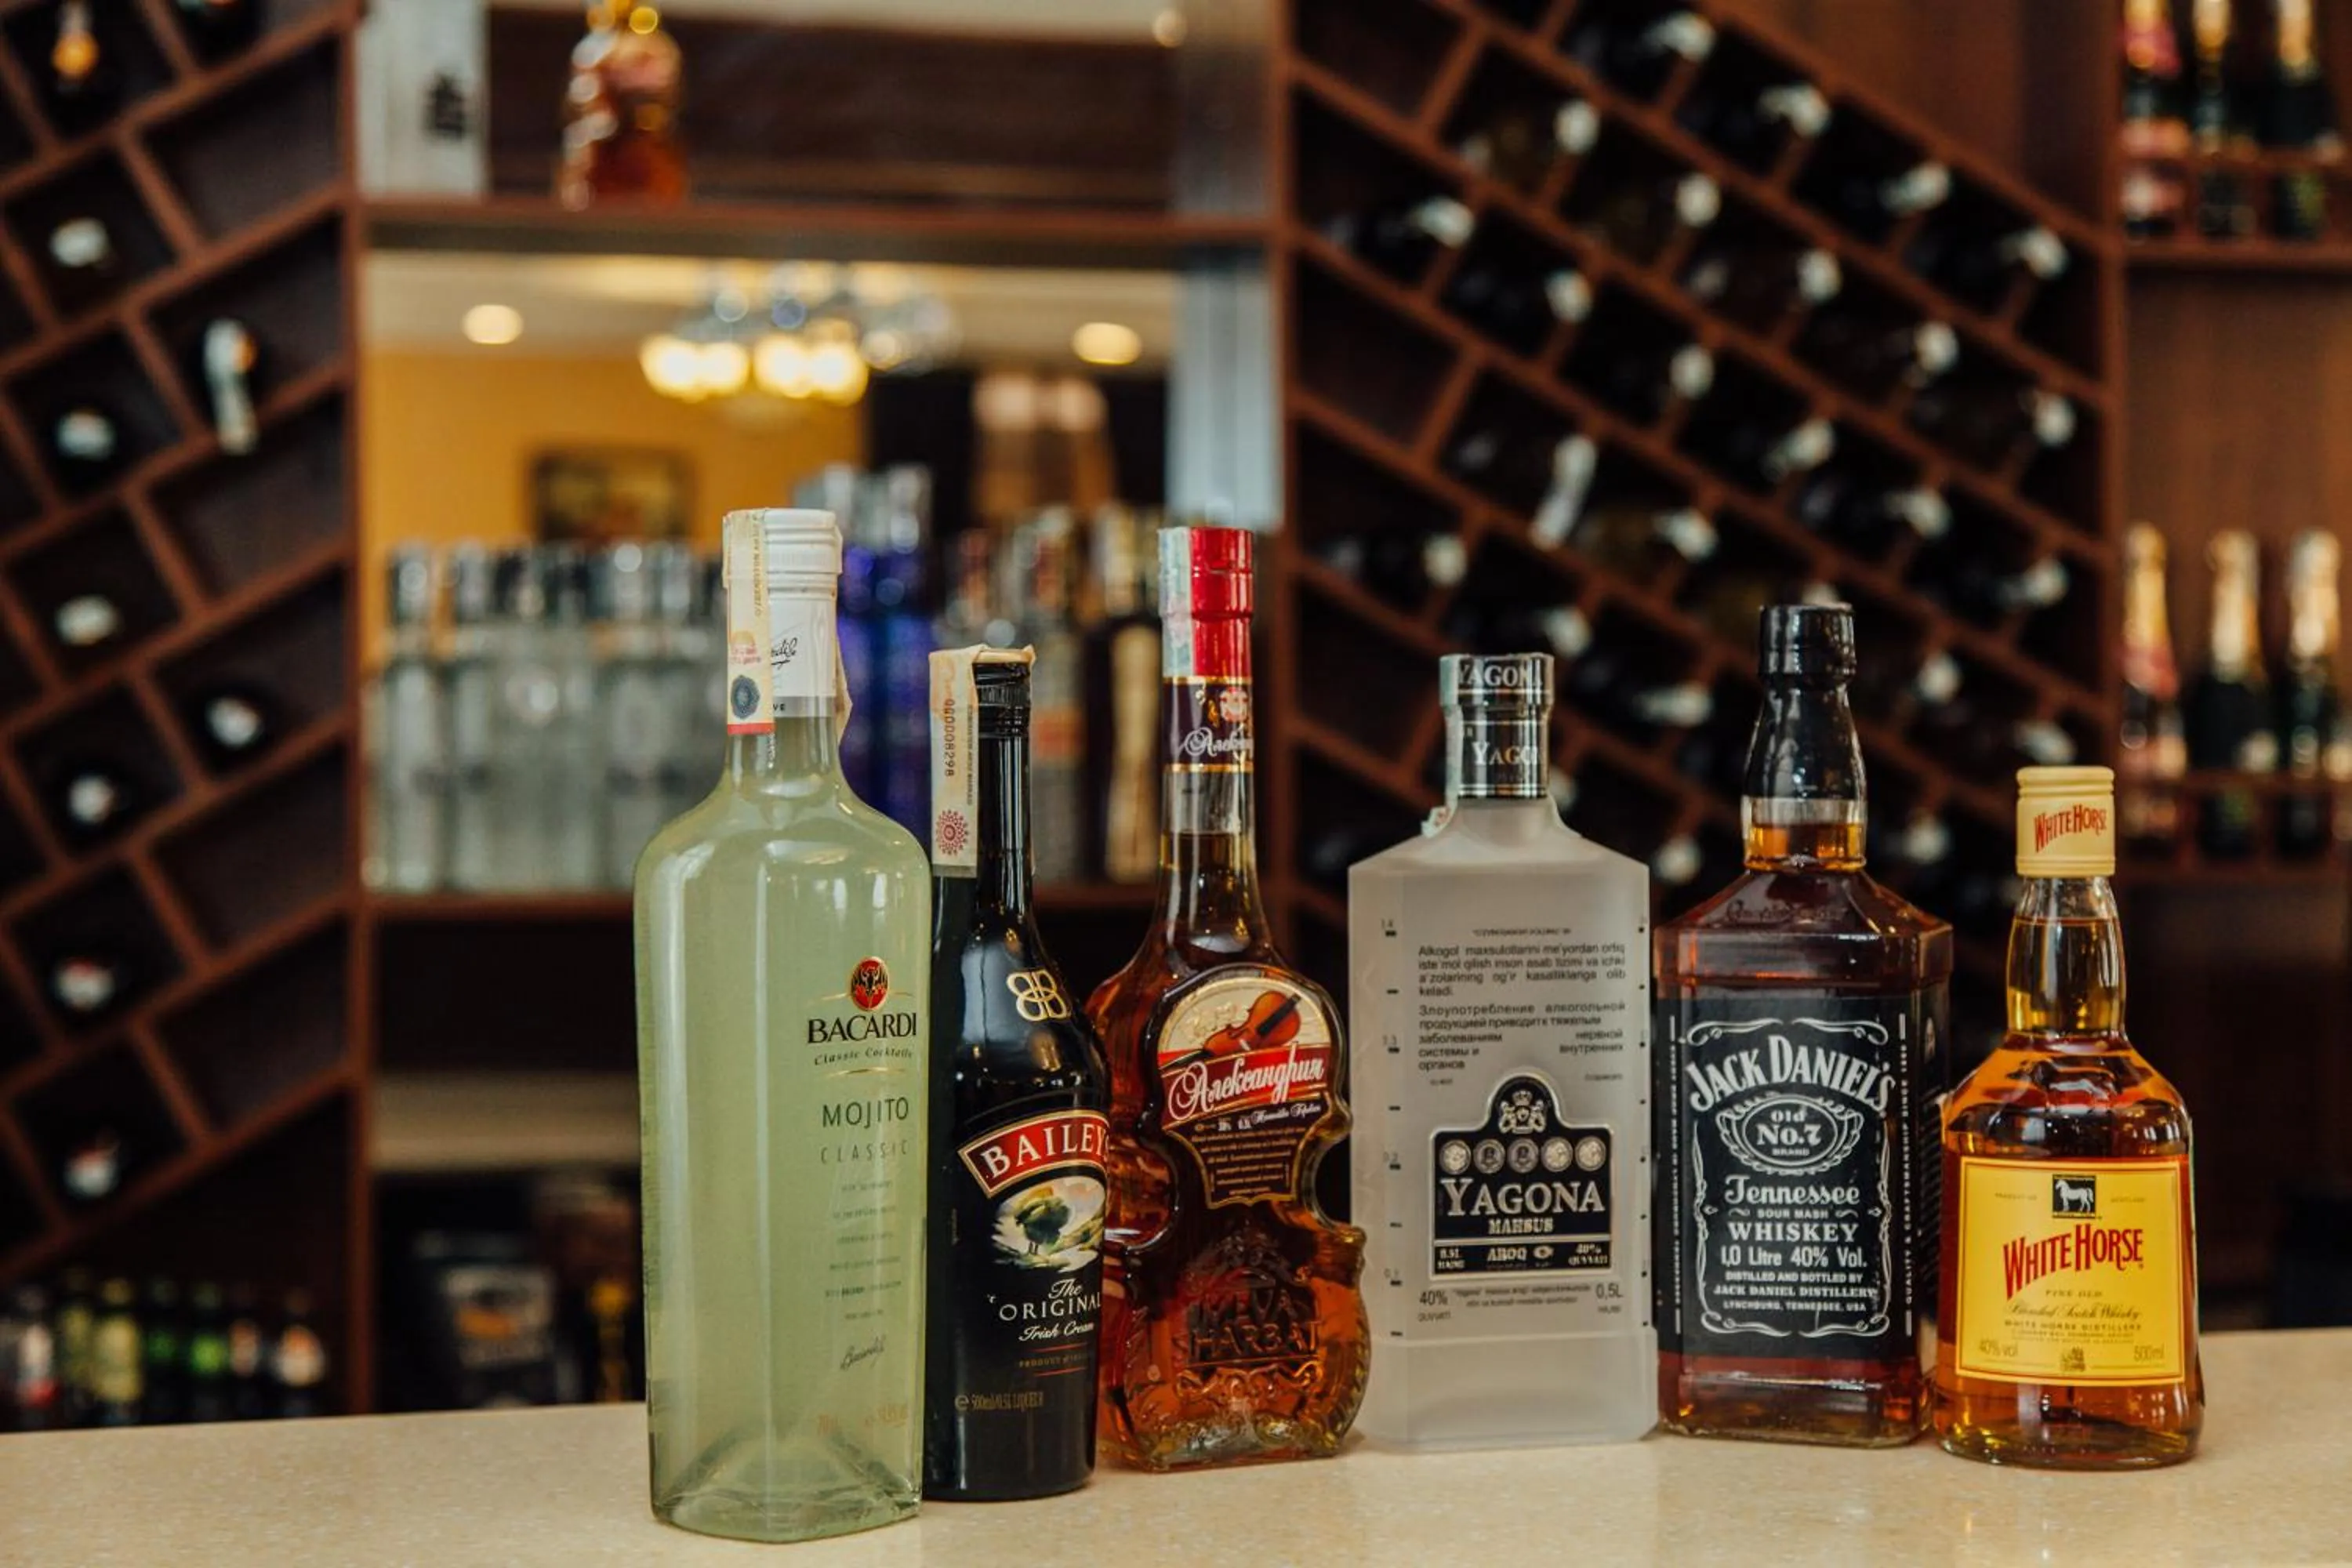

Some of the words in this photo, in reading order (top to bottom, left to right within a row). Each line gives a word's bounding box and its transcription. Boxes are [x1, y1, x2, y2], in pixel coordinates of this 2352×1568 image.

[2034, 811, 2072, 853] WHITE
[1418, 1004, 1535, 1018] Злоупотребление
[1544, 1000, 1625, 1013] алкогольной
[807, 1012, 917, 1044] BACARDI
[1418, 1032, 1503, 1045] заболеваниям
[1575, 1028, 1624, 1041] нервной
[814, 1051, 860, 1066] Classic
[1418, 1047, 1469, 1058] системы
[1418, 1059, 1465, 1073] органов
[1686, 1047, 1768, 1112] JACK
[822, 1097, 909, 1129] MOJITO
[1770, 1108, 1806, 1123] Old
[1756, 1123, 1822, 1146] No.7
[820, 1139, 908, 1165] CLASSIC
[1772, 1147, 1810, 1156] BRAND
[1439, 1177, 1606, 1216] YAGONA
[1725, 1174, 1861, 1205] Tennessee
[1757, 1207, 1791, 1219] SOUR
[1794, 1207, 1829, 1219] MASH
[1488, 1217, 1555, 1235] MAHSUS
[1727, 1221, 1860, 1243] WHISKEY
[1748, 1246, 1782, 1267] Litre
[1790, 1246, 1829, 1268] 40%
[1835, 1246, 1867, 1268] Vol.
[2002, 1232, 2072, 1301] WHITE
[2074, 1223, 2144, 1272] HORSE
[1725, 1272, 1776, 1282] DISTILLED
[1777, 1272, 1798, 1282] AND
[1801, 1272, 1846, 1283] BOTTLED
[1848, 1273, 1864, 1283] BY
[1047, 1278, 1083, 1299] The
[1595, 1282, 1624, 1300] 0,5L
[1713, 1285, 1746, 1295] JACK
[1749, 1286, 1796, 1296] DANIEL
[1799, 1287, 1877, 1298] DISTILLERY
[999, 1291, 1102, 1322] ORIGINAL
[1418, 1290, 1448, 1306] 40%
[1846, 1302, 1867, 1312] USA
[1018, 1323, 1060, 1341] Irish
